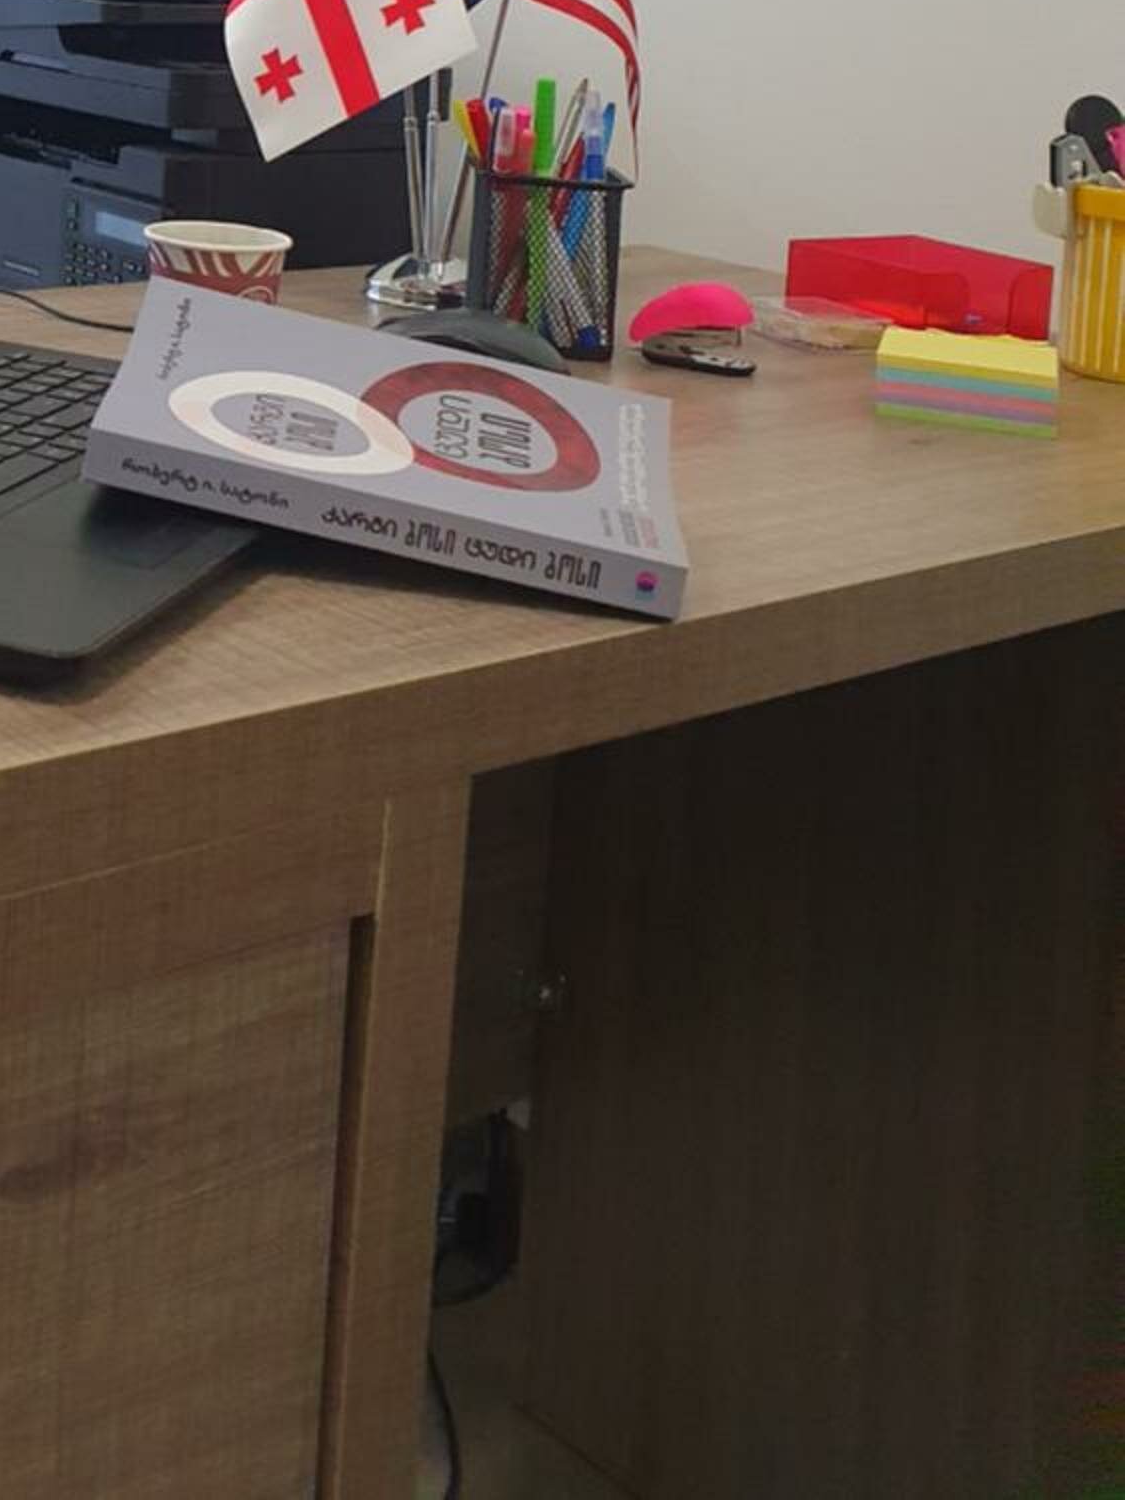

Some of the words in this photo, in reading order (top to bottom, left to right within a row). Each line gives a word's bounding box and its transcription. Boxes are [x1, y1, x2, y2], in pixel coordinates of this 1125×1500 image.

[434, 394, 473, 459] ცუდი
[478, 412, 532, 469] ბოსი
[405, 518, 455, 556] ბოსი
[544, 551, 603, 589] ბოსი
